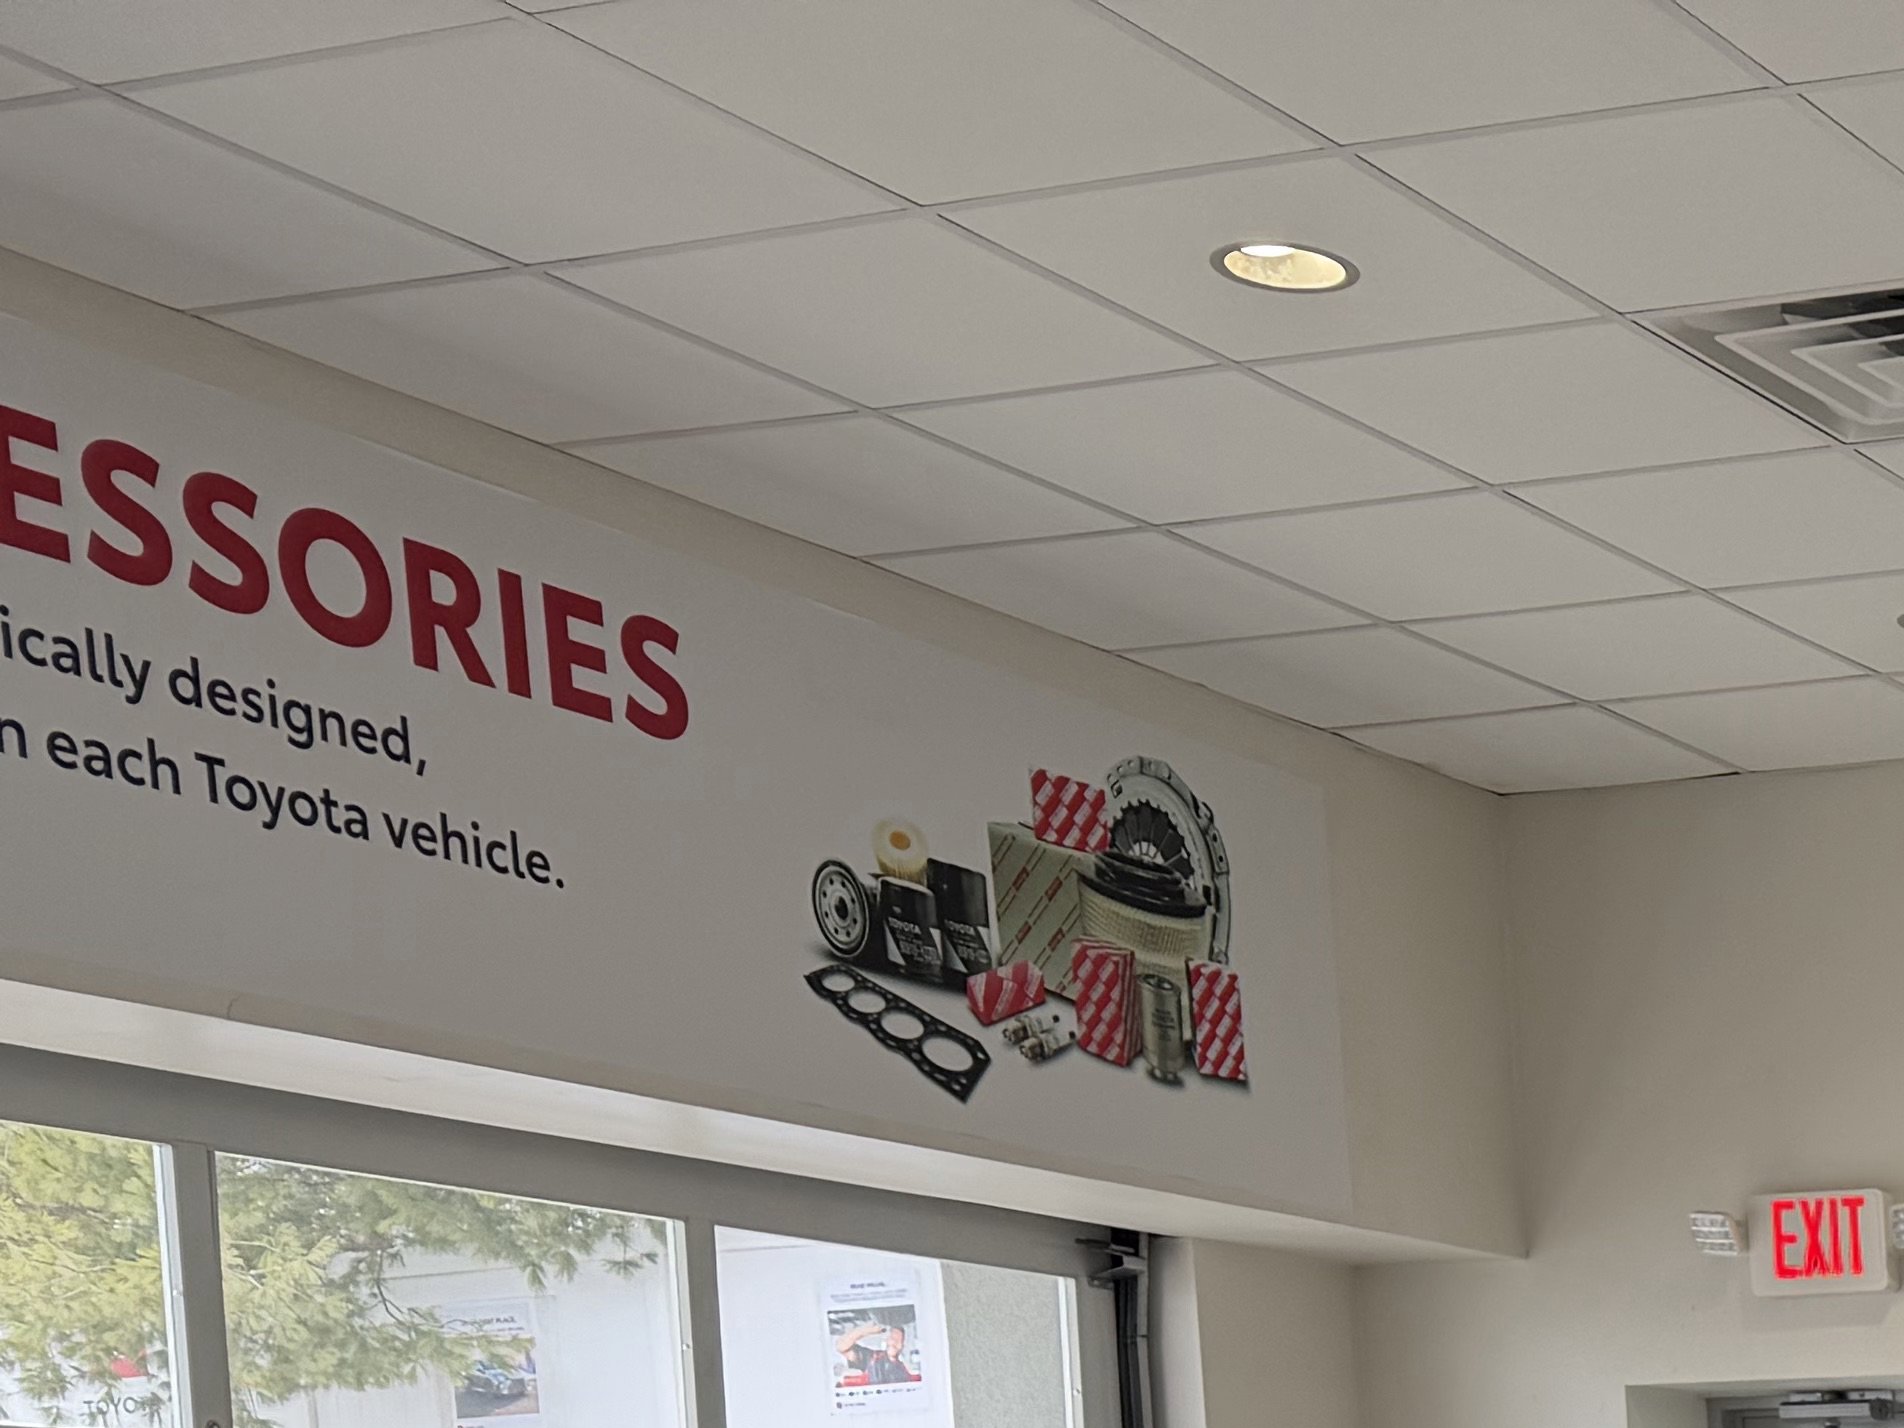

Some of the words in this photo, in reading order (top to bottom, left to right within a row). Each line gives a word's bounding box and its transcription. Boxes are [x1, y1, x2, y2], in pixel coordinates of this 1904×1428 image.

[0, 407, 690, 741] ESSORIES
[0, 604, 151, 704] ically
[167, 656, 429, 777] designed,
[46, 731, 181, 794] each
[195, 751, 370, 841] Toyota
[381, 810, 566, 888] vehicle.
[1772, 1196, 1865, 1279] EXIT
